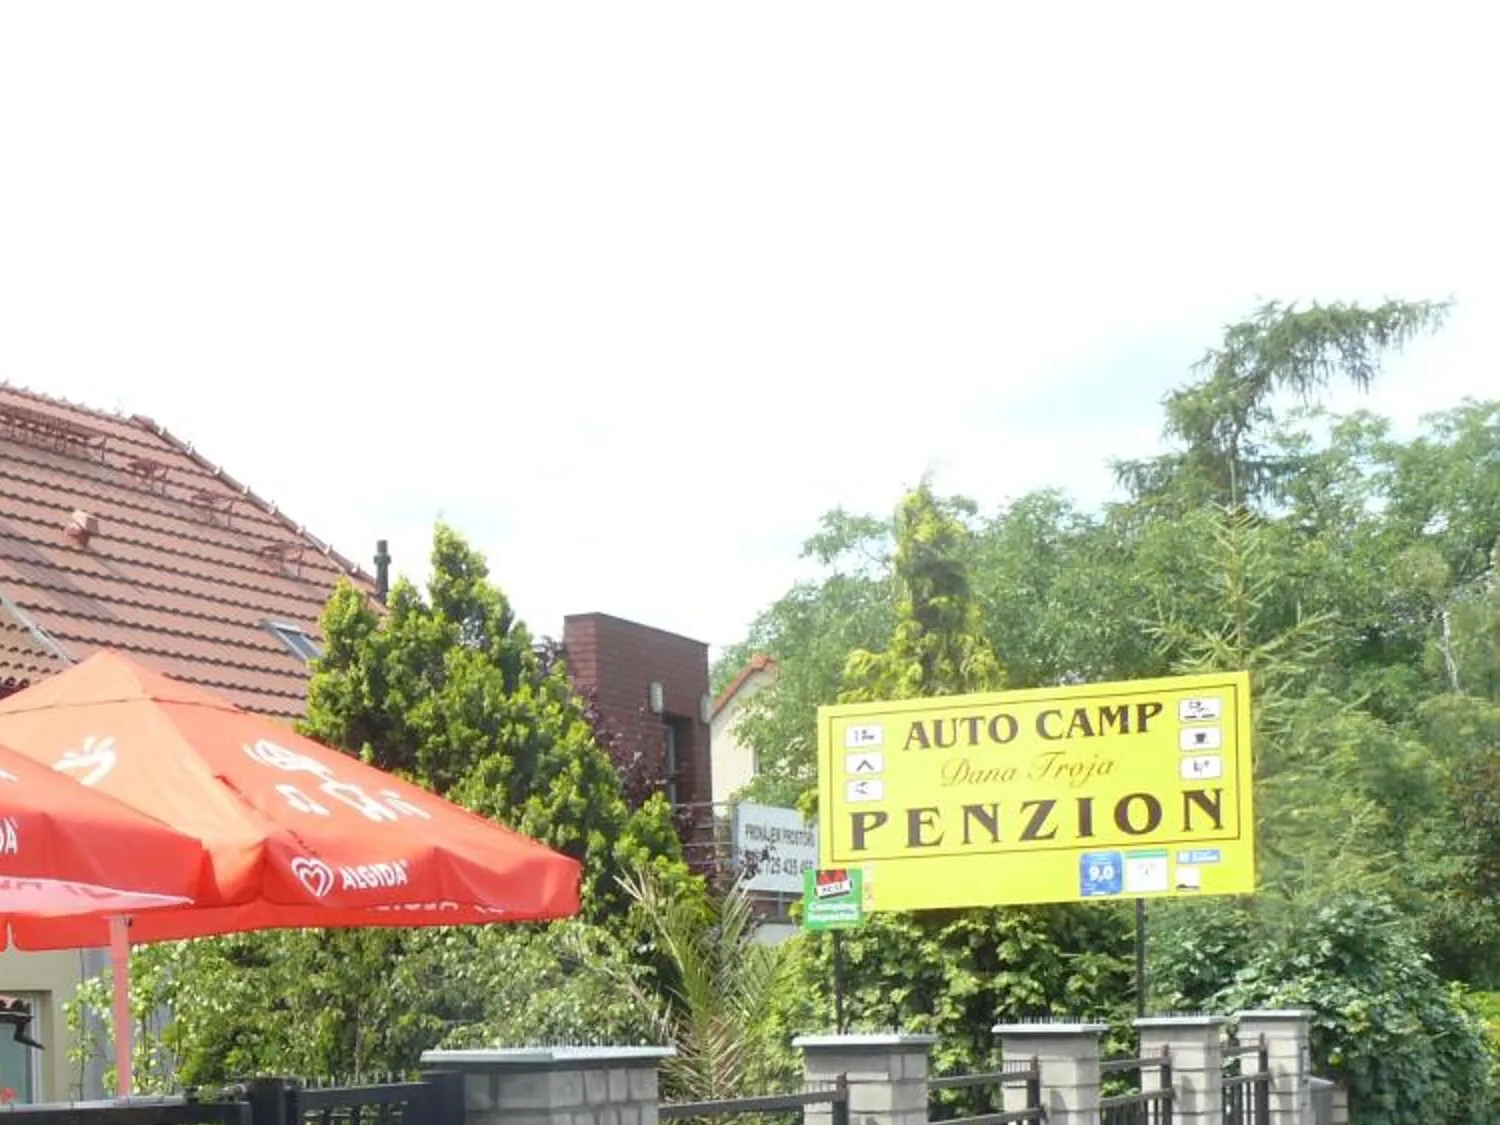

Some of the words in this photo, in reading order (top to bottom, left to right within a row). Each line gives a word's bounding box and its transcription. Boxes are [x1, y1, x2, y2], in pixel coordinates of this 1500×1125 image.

[902, 713, 1019, 751] AUTO
[1035, 701, 1164, 742] CAMP
[940, 757, 1019, 787] Dana
[1027, 751, 1115, 789] Troja
[848, 788, 1224, 852] PENZION
[338, 860, 409, 889] ALGIDA
